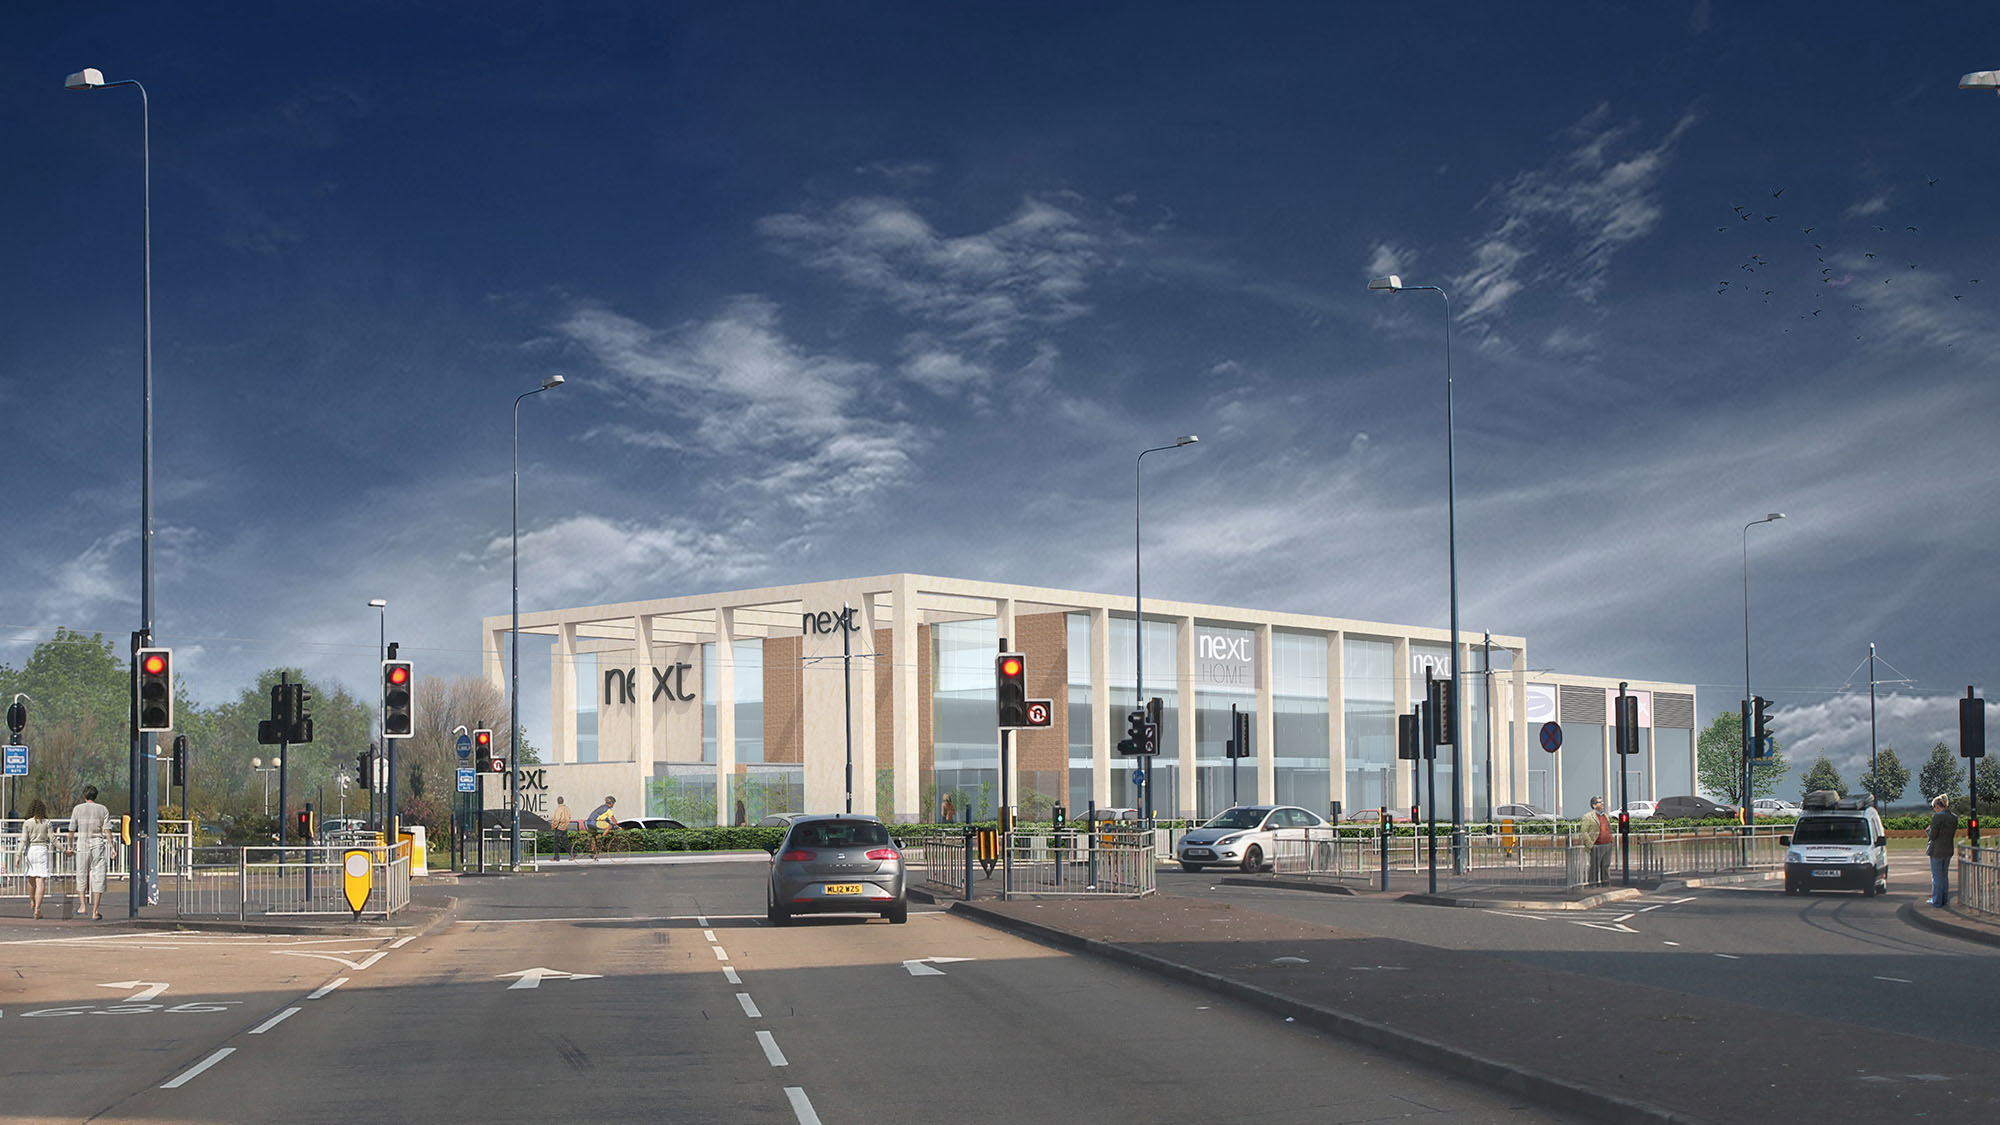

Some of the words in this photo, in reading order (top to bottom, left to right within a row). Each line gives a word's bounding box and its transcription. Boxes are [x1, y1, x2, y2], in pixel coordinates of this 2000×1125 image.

[802, 608, 861, 635] next
[1199, 634, 1252, 662] next
[1202, 662, 1248, 684] HOME
